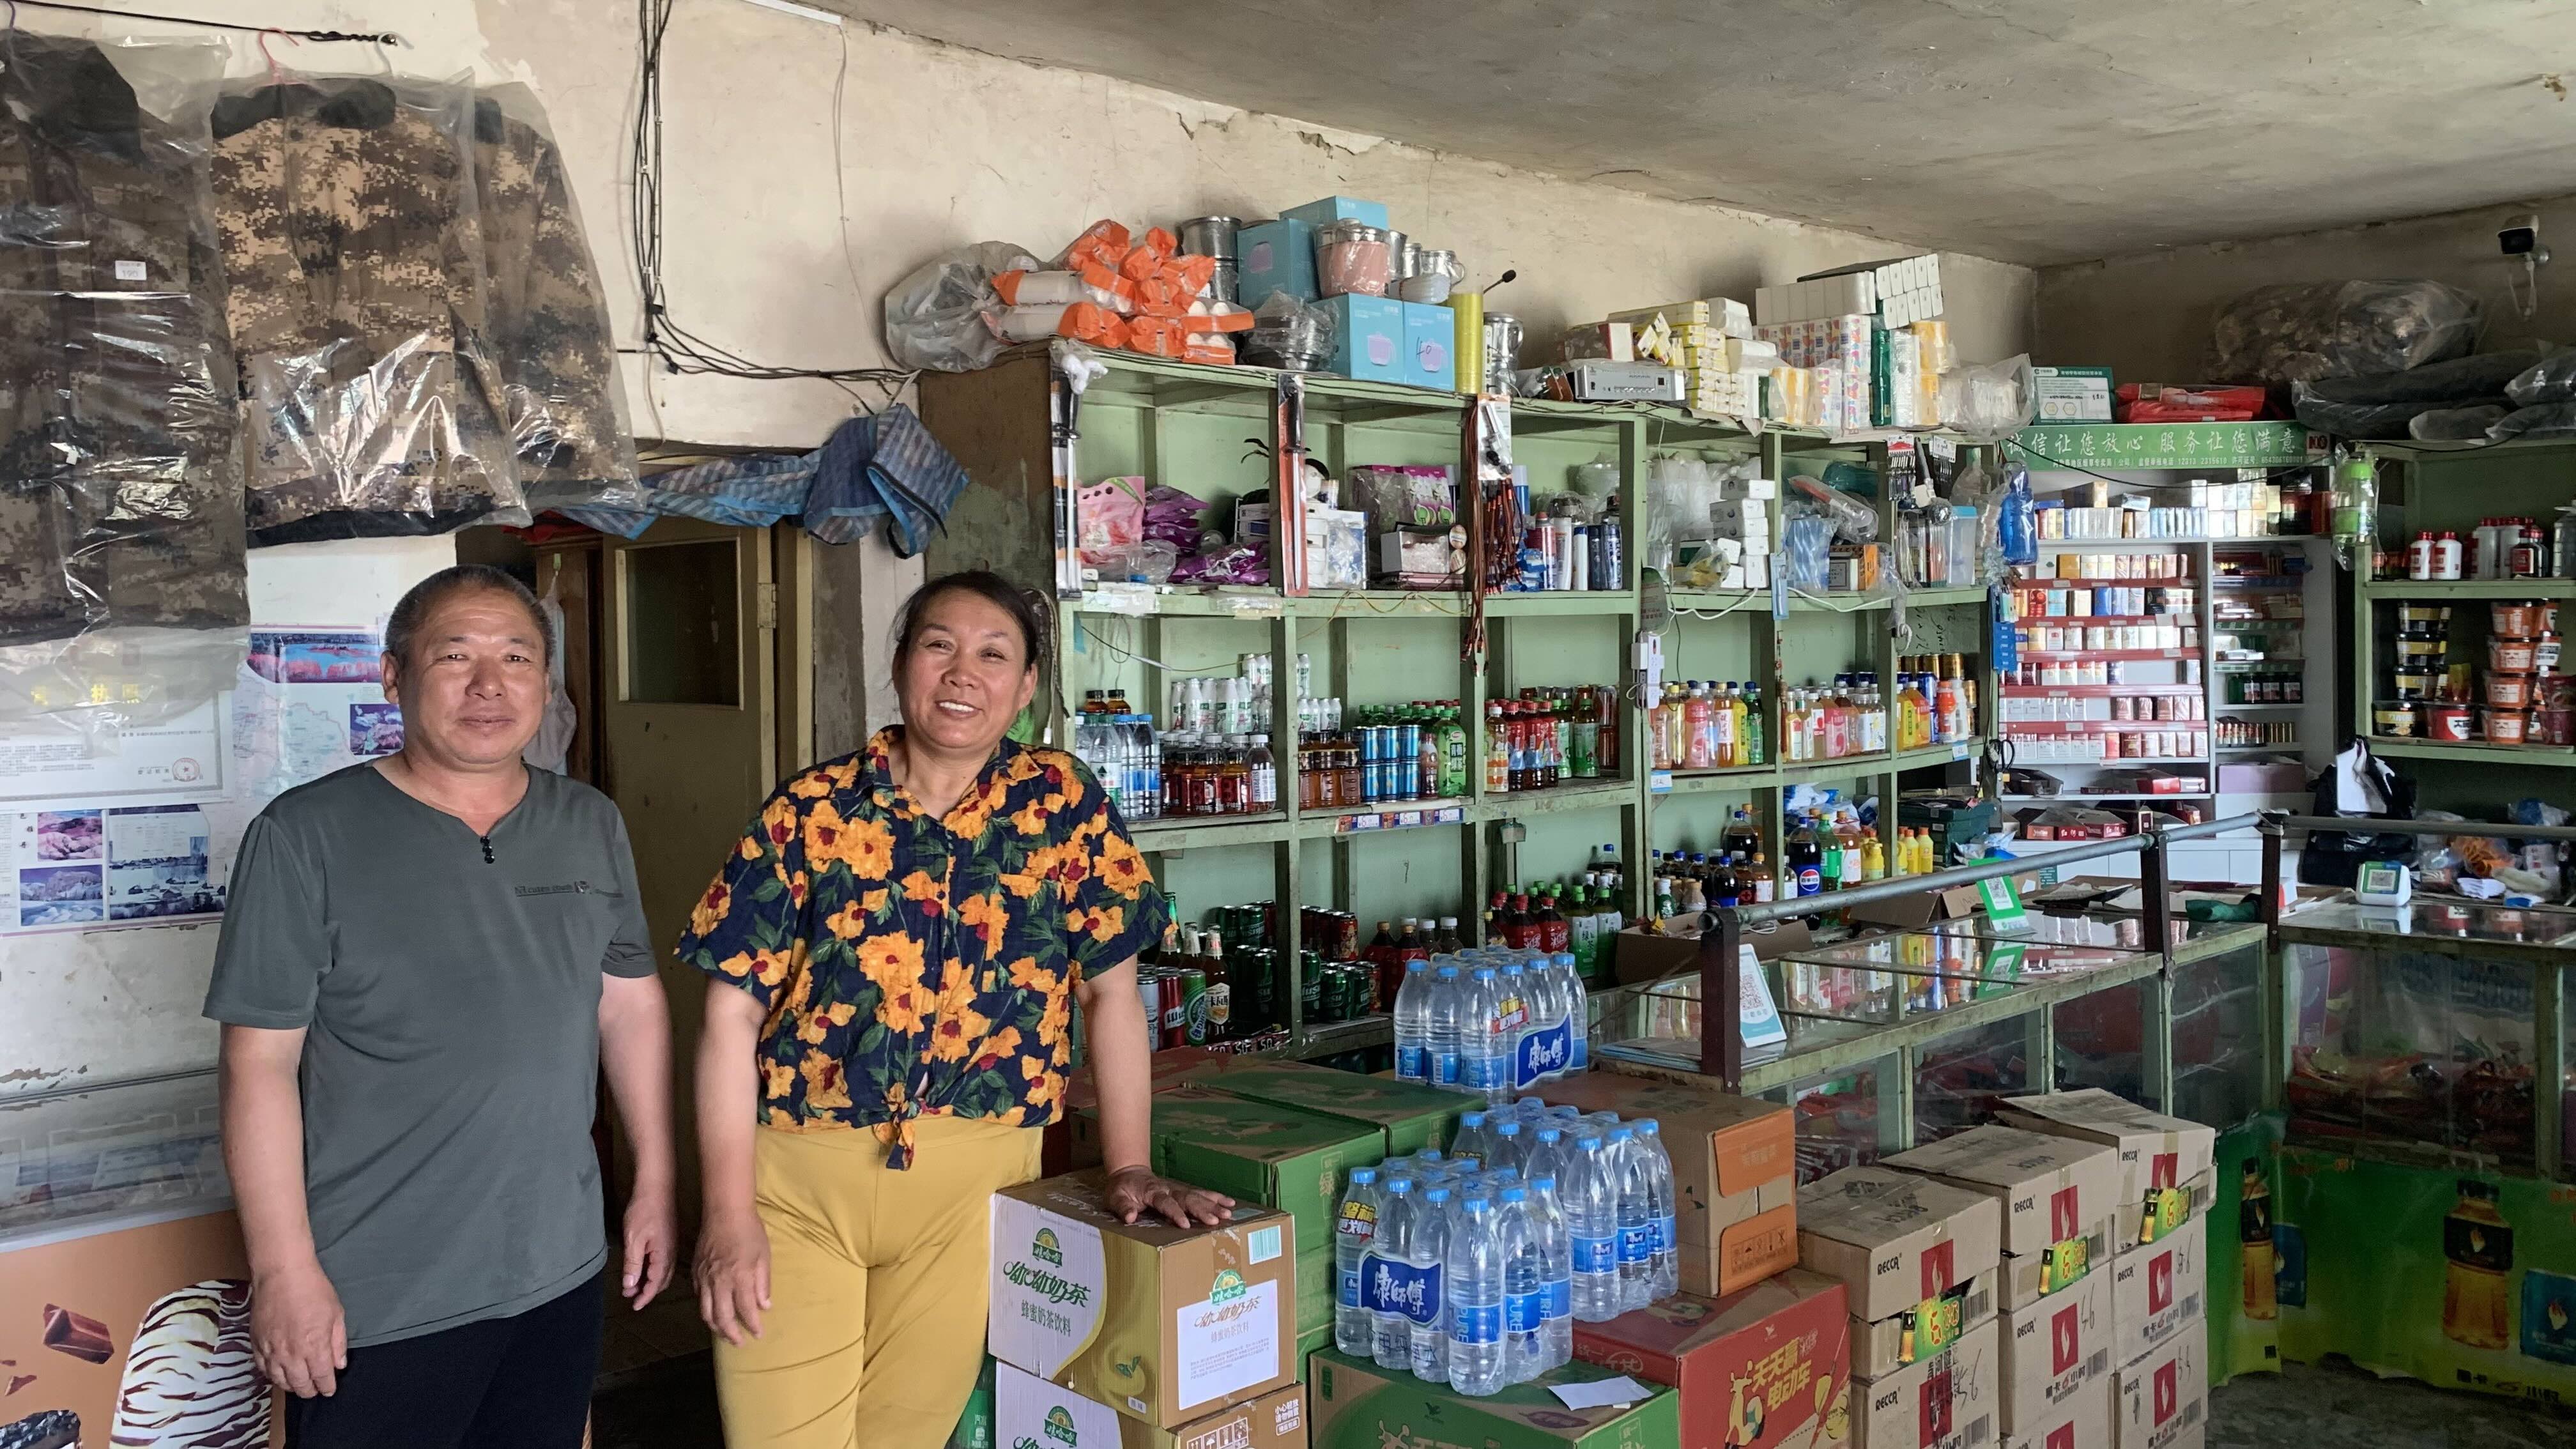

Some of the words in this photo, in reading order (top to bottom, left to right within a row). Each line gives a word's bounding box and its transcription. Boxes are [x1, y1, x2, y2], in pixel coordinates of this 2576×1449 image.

[2007, 431, 2143, 457] 诚信让您放心
[2160, 429, 2296, 454] 服务让您满意
[2122, 1150, 2138, 1162] RECCA
[2014, 1197, 2034, 1213] RECCA
[1877, 1256, 1899, 1275] RECCA
[2118, 1266, 2134, 1283] RECCA
[1022, 1300, 1071, 1337] 蜂蜜奶茶饮料
[1510, 1296, 1524, 1331] PURE
[1456, 1307, 1469, 1343] PURE
[2017, 1320, 2035, 1339] RECCA
[1767, 1360, 1812, 1412] 电动车
[1876, 1390, 1898, 1412] RECCA
